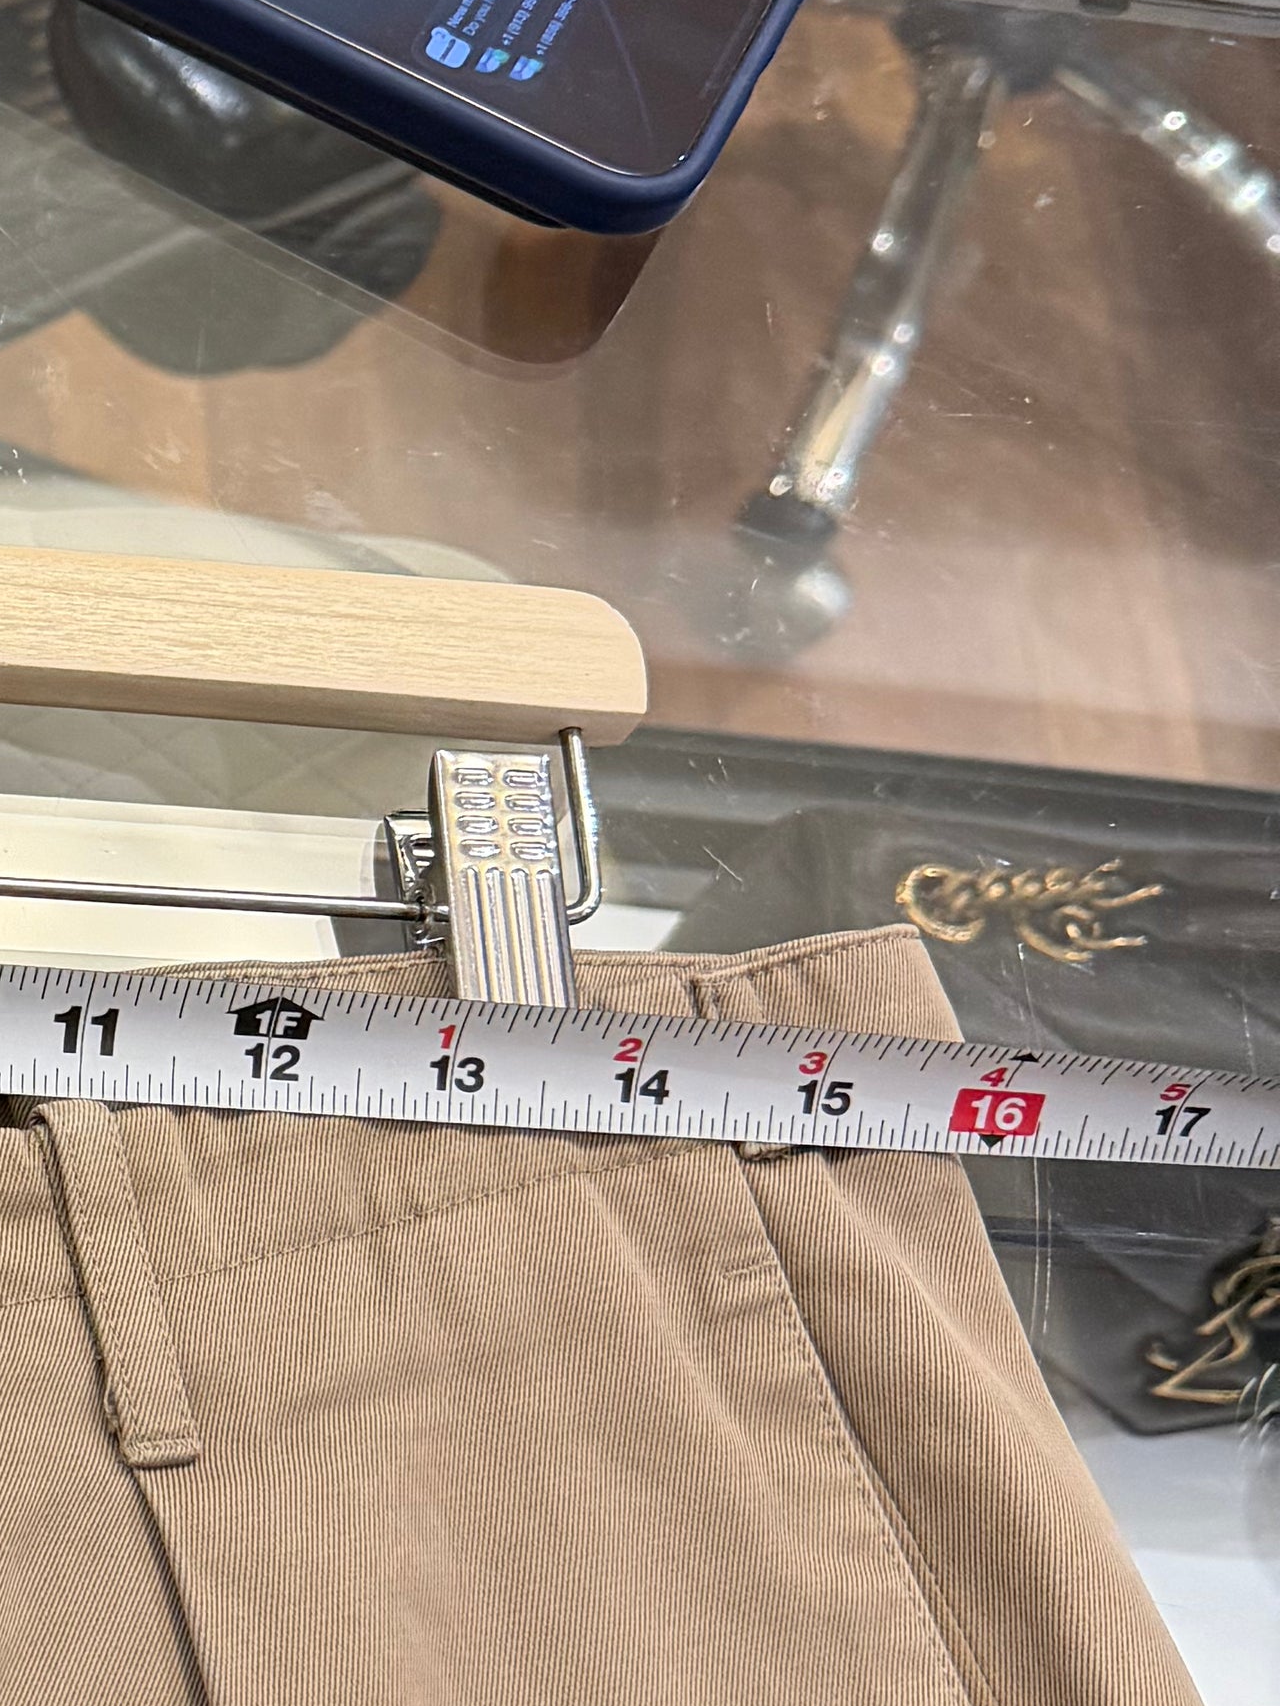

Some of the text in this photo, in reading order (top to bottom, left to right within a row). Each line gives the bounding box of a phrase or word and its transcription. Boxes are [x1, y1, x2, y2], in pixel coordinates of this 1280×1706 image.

[53, 1005, 120, 1056] 11
[255, 1011, 301, 1037] 1F
[440, 1024, 456, 1049] 1
[245, 1042, 300, 1082] 12
[614, 1038, 641, 1062] 2
[800, 1051, 826, 1075] 3
[430, 1055, 484, 1093] 13
[615, 1067, 670, 1105] 14
[981, 1066, 1007, 1088] 4
[797, 1079, 853, 1117] 15
[1159, 1082, 1190, 1101] 5
[970, 1096, 1026, 1131] 16
[1155, 1105, 1211, 1138] 17
